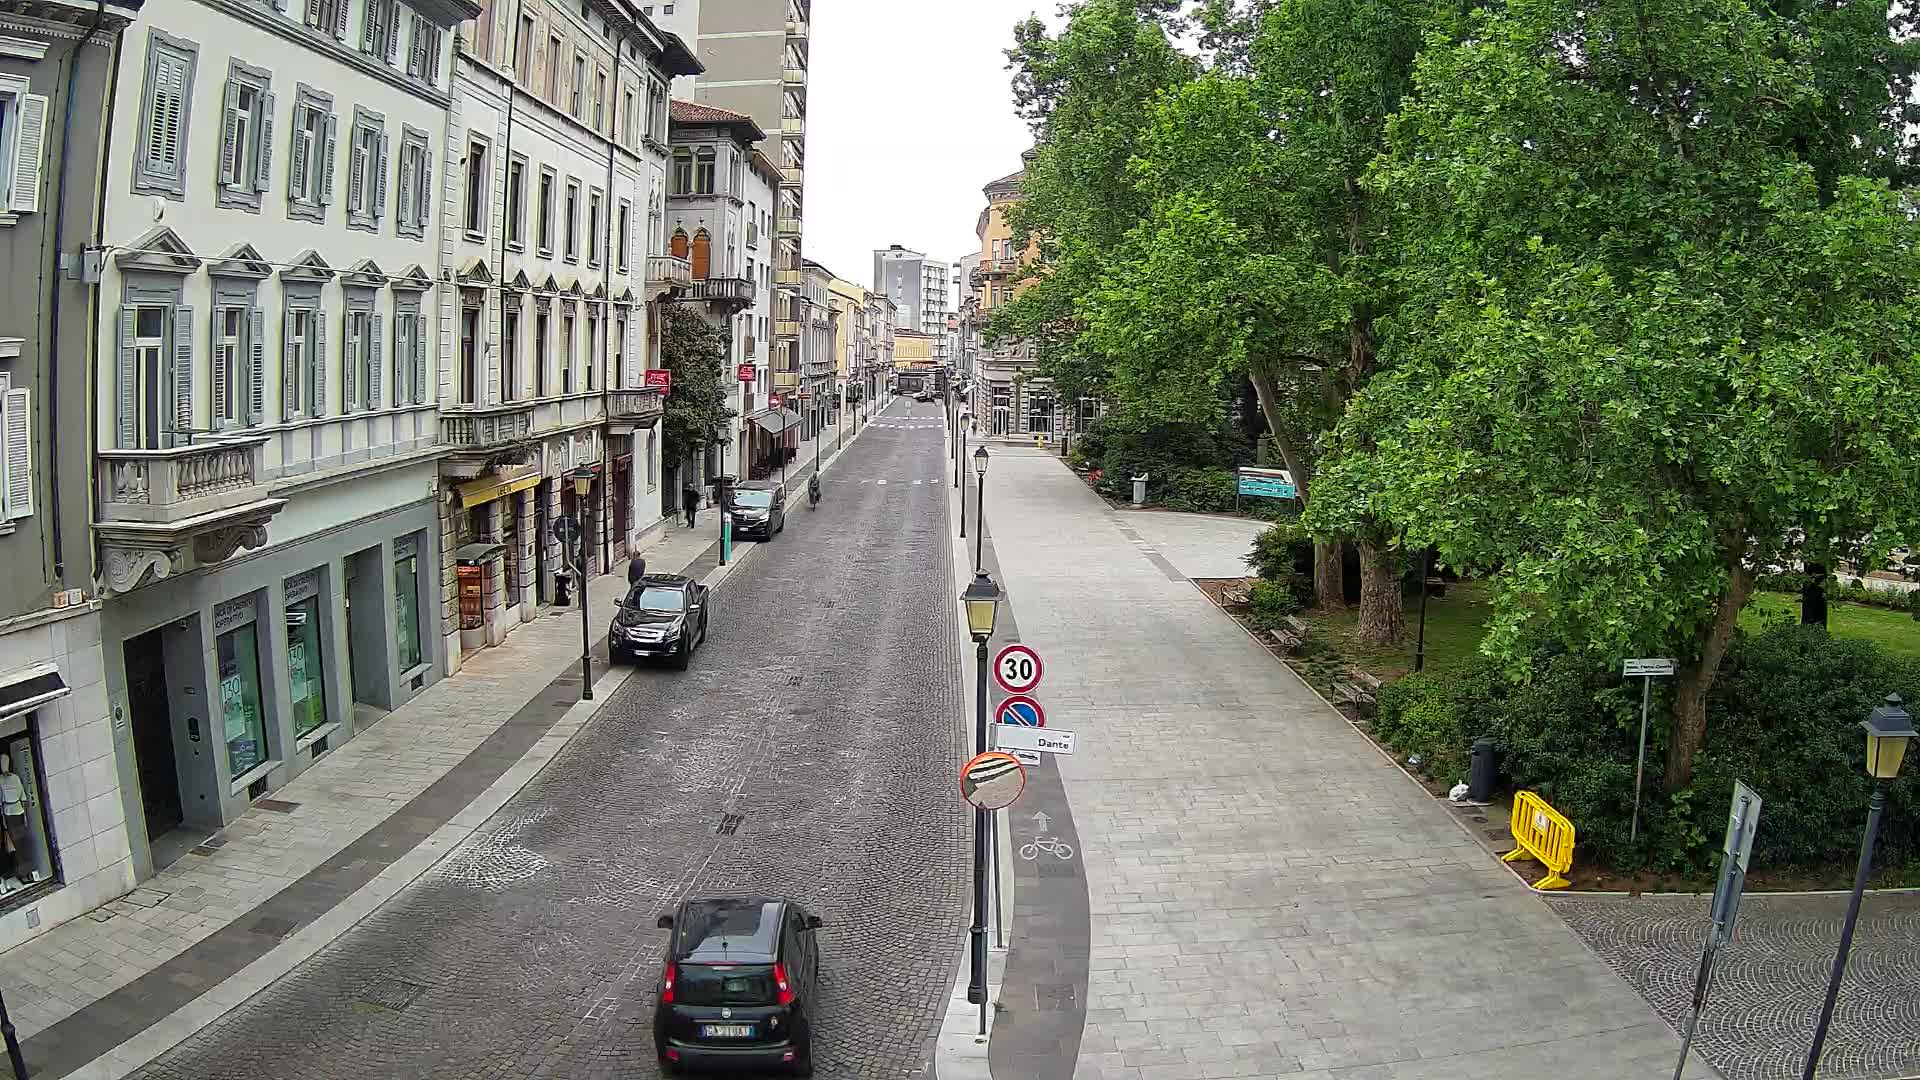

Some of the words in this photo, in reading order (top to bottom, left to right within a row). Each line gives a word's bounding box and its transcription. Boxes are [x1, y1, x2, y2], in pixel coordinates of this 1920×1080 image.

[1005, 658, 1032, 680] 30
[222, 677, 240, 699] 130
[1038, 738, 1069, 750] Dante
